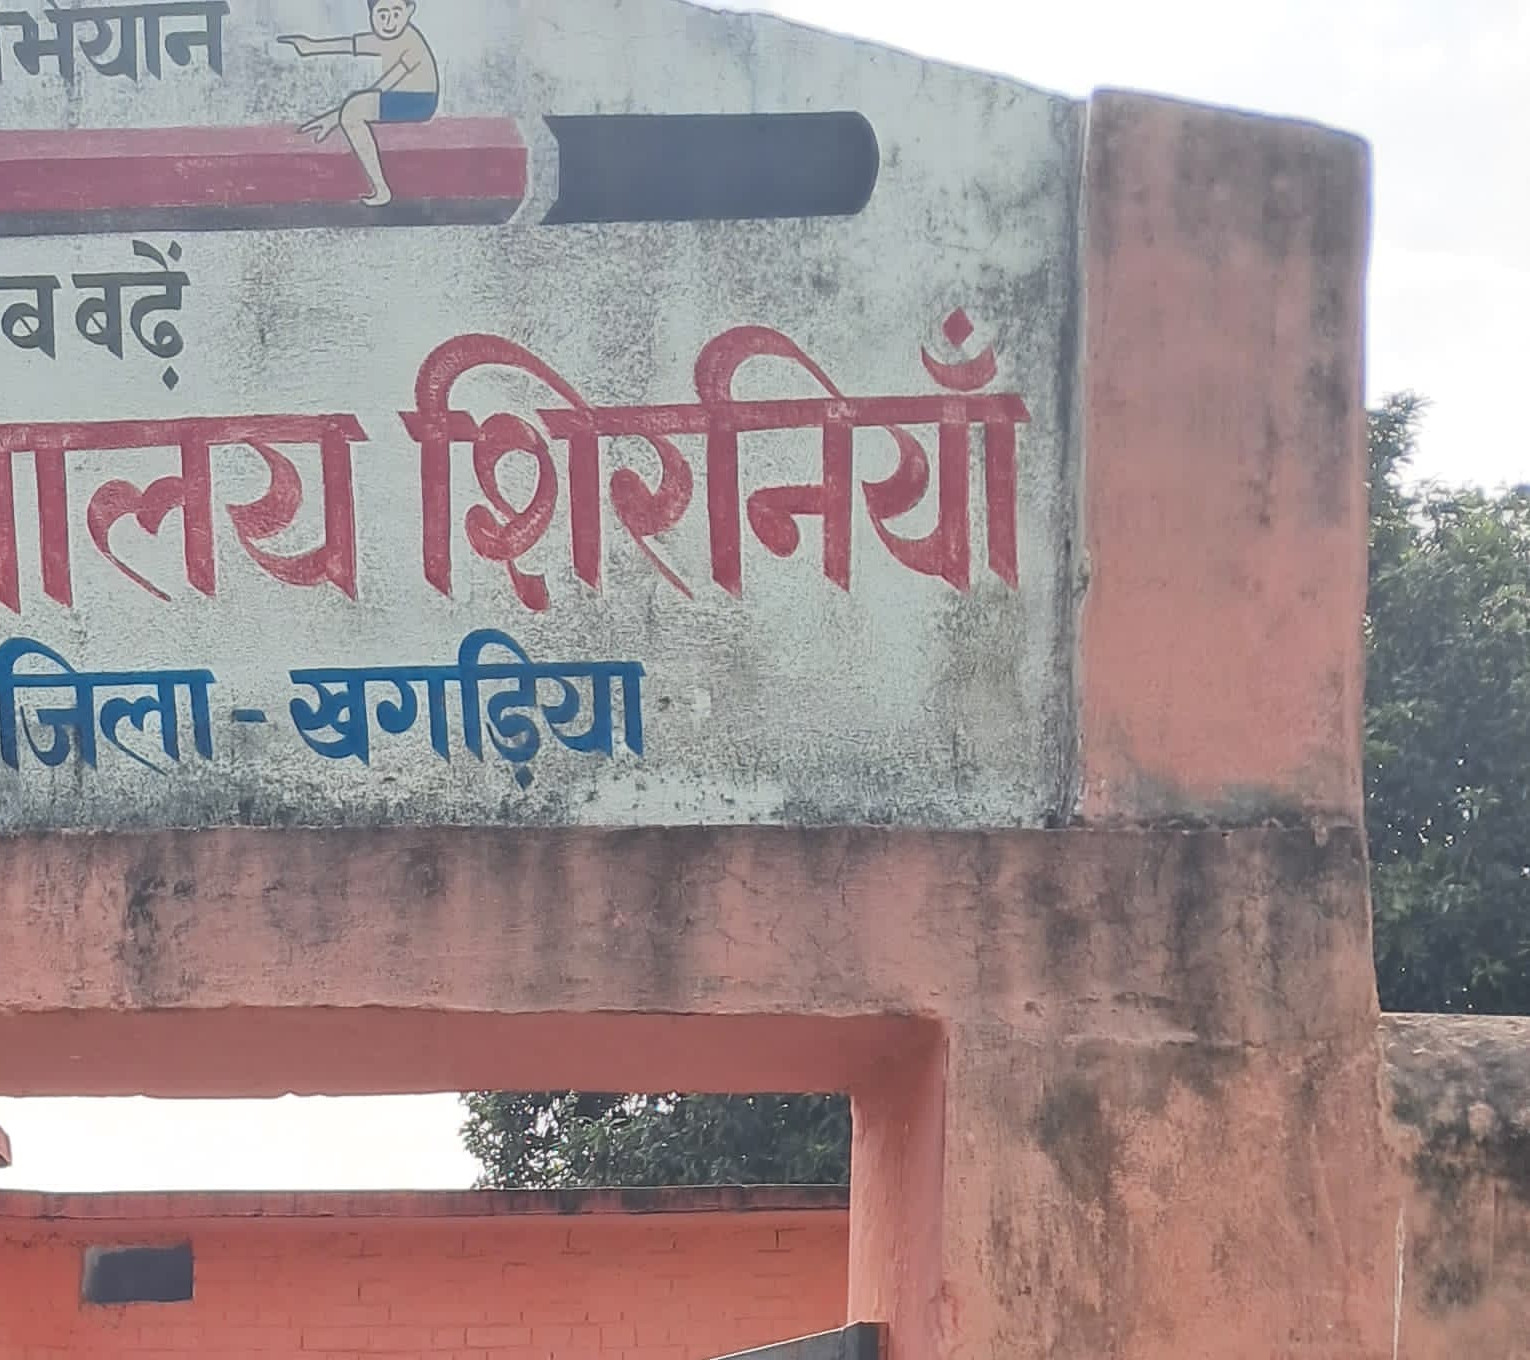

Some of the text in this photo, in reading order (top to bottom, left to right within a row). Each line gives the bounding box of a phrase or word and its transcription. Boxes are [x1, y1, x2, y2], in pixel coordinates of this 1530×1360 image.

[71, 239, 190, 391] बढ़ें
[398, 306, 1032, 612] शिरनियाँ
[289, 630, 647, 788] खगड़िया
